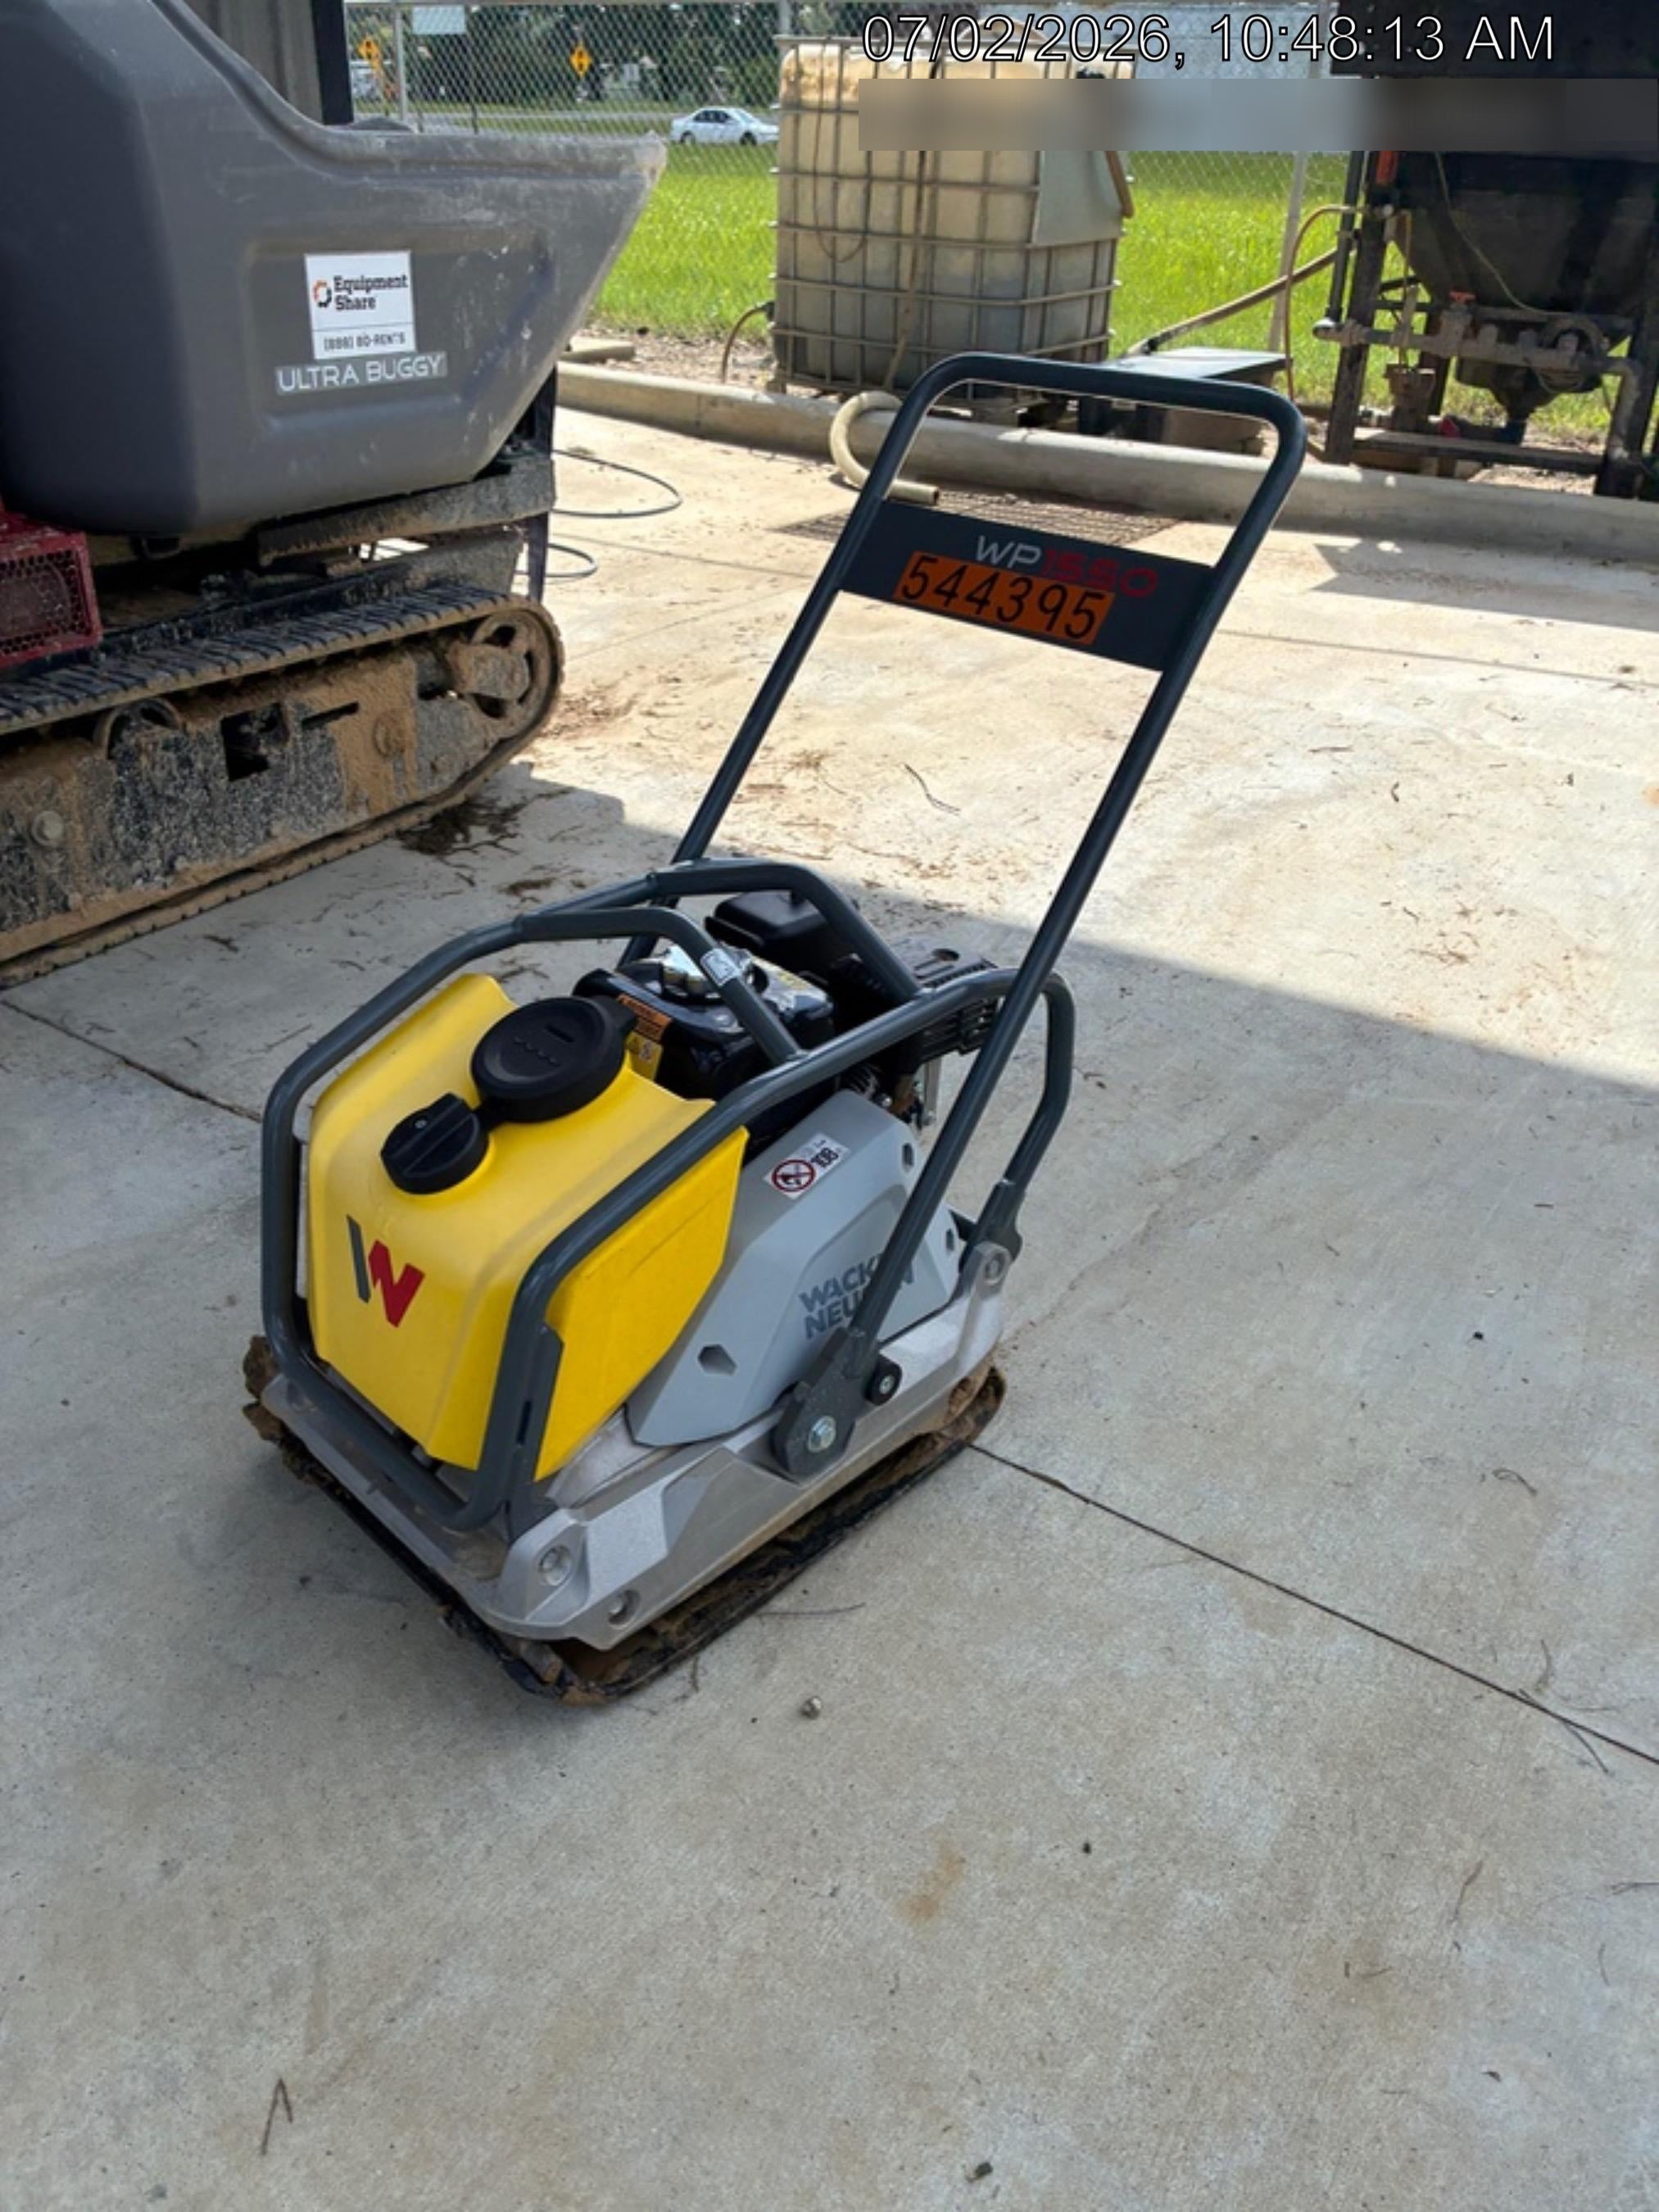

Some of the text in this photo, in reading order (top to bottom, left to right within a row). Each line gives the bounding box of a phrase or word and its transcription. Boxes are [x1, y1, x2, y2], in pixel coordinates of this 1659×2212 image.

[333, 275, 409, 294] Equipment
[335, 294, 377, 310] Share
[279, 353, 442, 392] ULTRA BUGGY
[900, 555, 1105, 641] 544395
